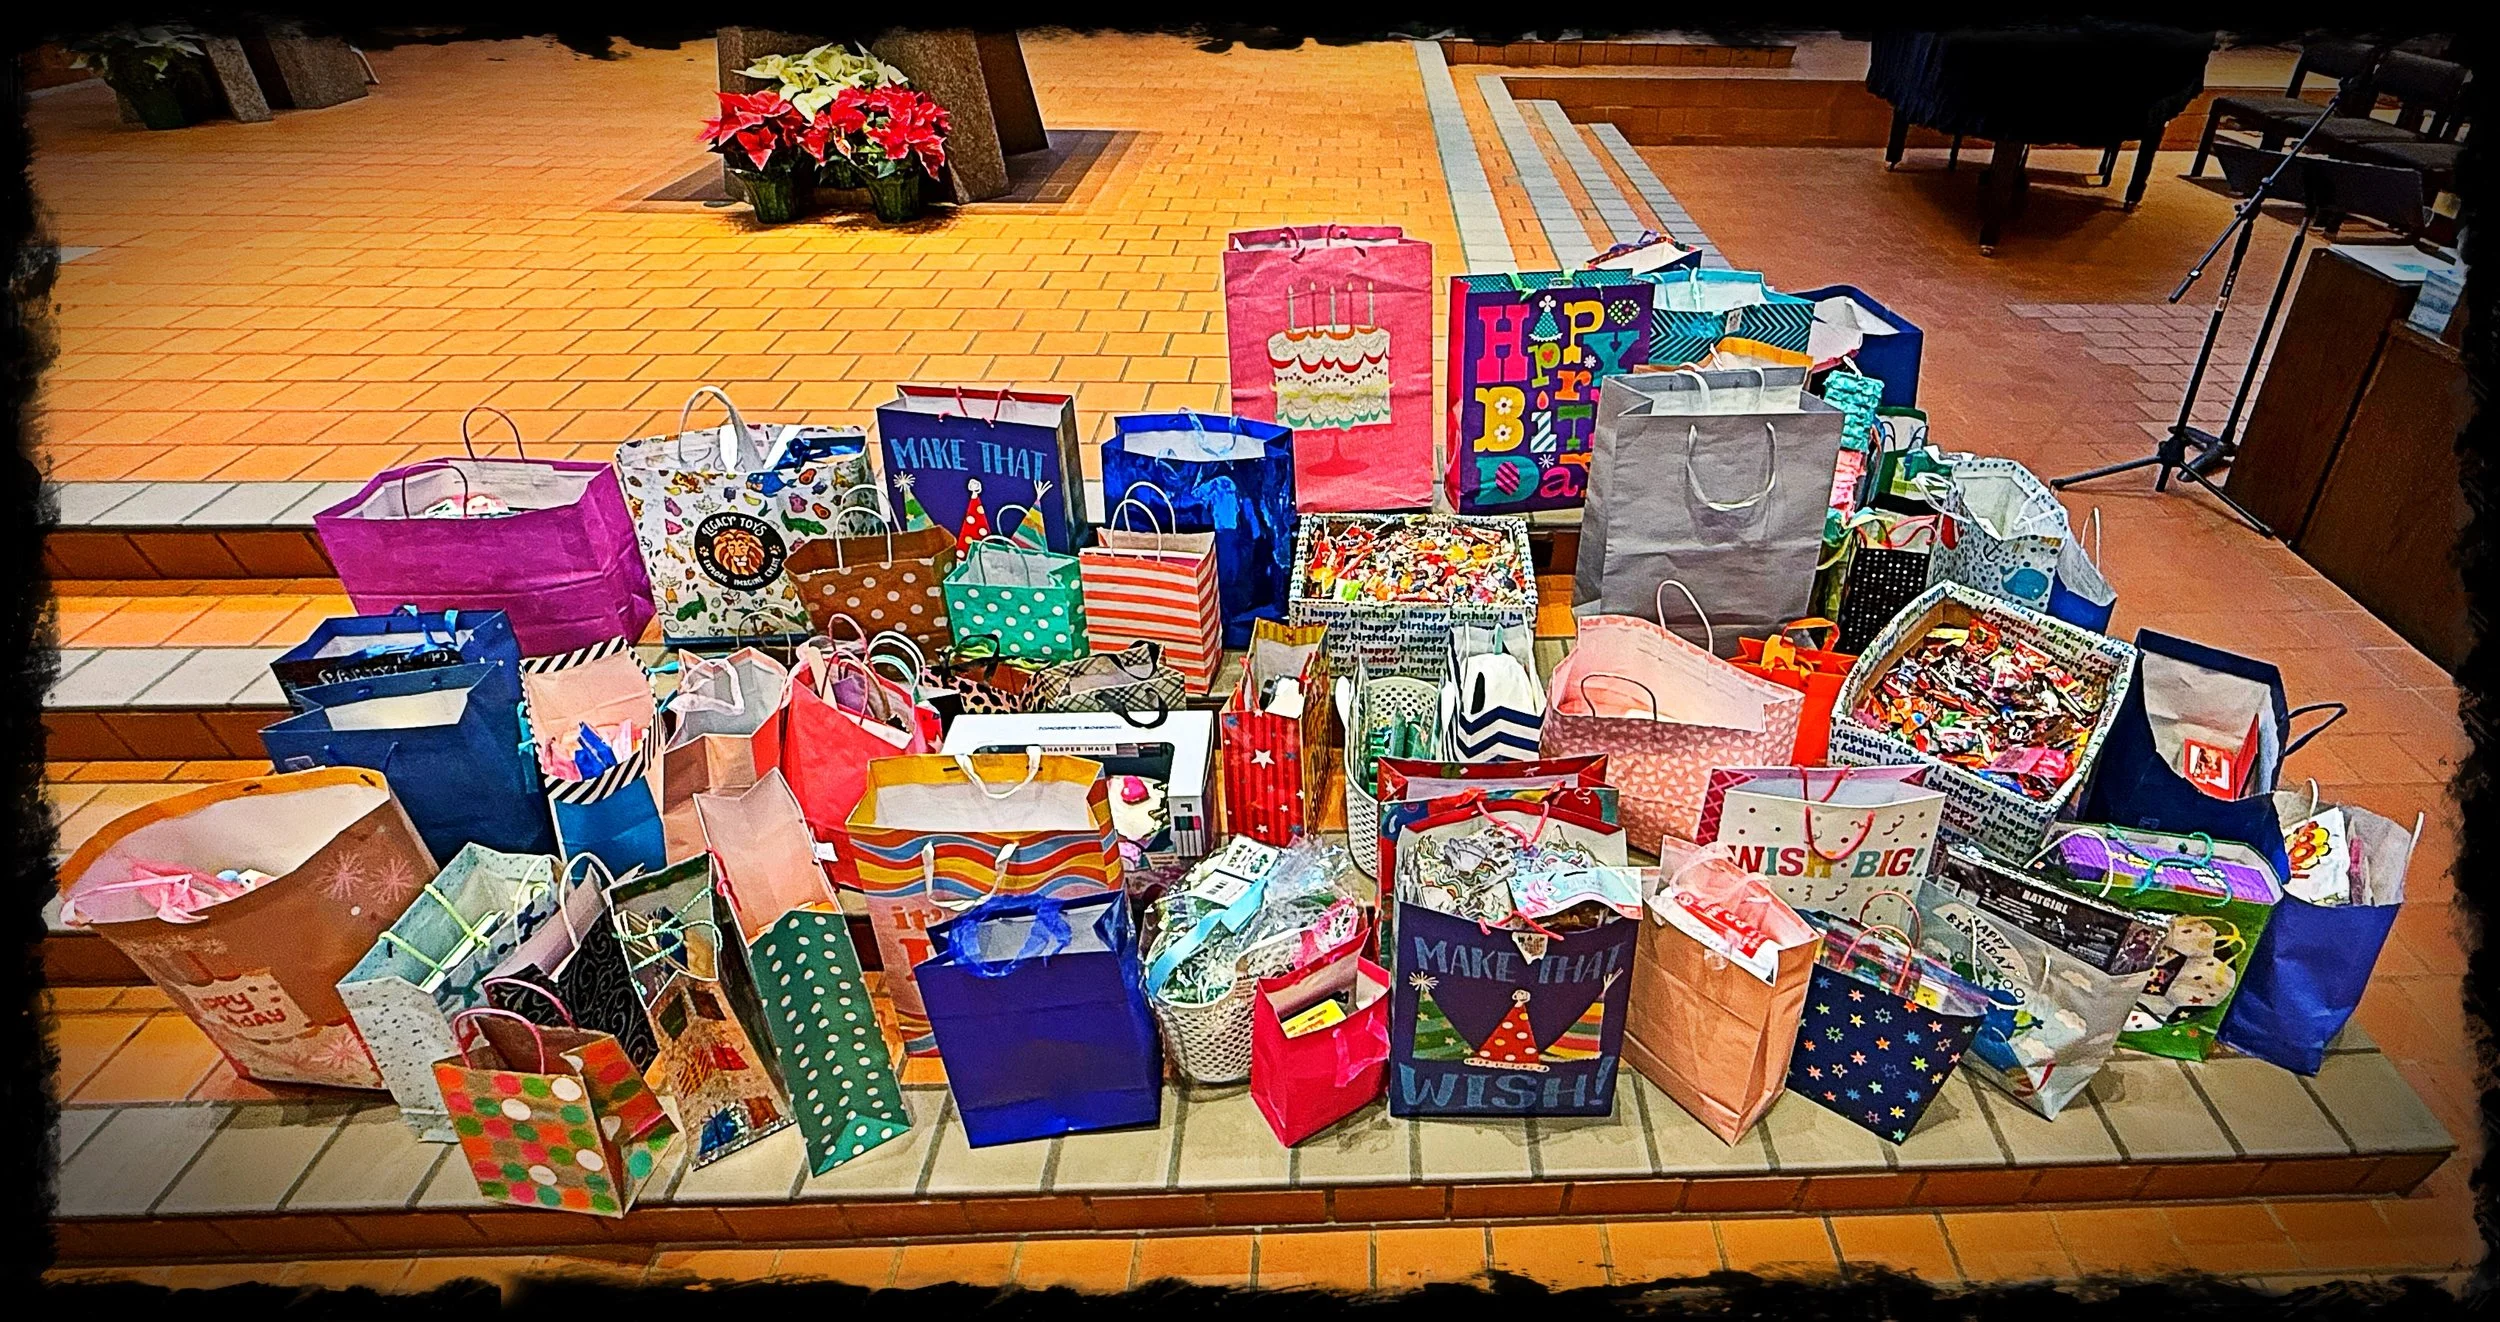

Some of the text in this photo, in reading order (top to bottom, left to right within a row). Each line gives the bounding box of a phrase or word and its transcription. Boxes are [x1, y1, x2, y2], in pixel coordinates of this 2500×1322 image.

[890, 437, 1048, 481] MAKE THAT
[701, 516, 767, 537] LEGACY TOYS
[1310, 609, 1346, 620] happy
[1351, 609, 1405, 620] birthday!
[1409, 610, 1446, 621] happy
[1450, 610, 1504, 622] birthday!
[1360, 621, 1396, 632] happy
[1351, 632, 1405, 644] birthday!
[1409, 634, 1446, 644] happy
[1360, 645, 1396, 656] happy
[2036, 619, 2093, 650] birthday!
[2097, 644, 2122, 661] ppy
[2042, 633, 2078, 656] happy
[1367, 667, 1396, 676] appy
[1409, 656, 1445, 665] happy
[1833, 730, 1892, 754] birthday!
[1841, 744, 1881, 763] happy
[1928, 777, 1995, 814] birthday!
[1943, 771, 2047, 824] happy birthda
[1943, 802, 1978, 822] appy
[1940, 812, 1985, 838] thday!
[1728, 846, 1833, 879] WISH
[1851, 848, 1925, 878] BIG!
[2021, 889, 2069, 915] BATGIRL
[1946, 913, 2016, 971] BIRHDAY
[1968, 914, 2011, 951] HAPPY
[1414, 936, 1518, 983] MAKE
[1538, 942, 1625, 984] THAT
[1398, 1055, 1616, 1108] WISH!
